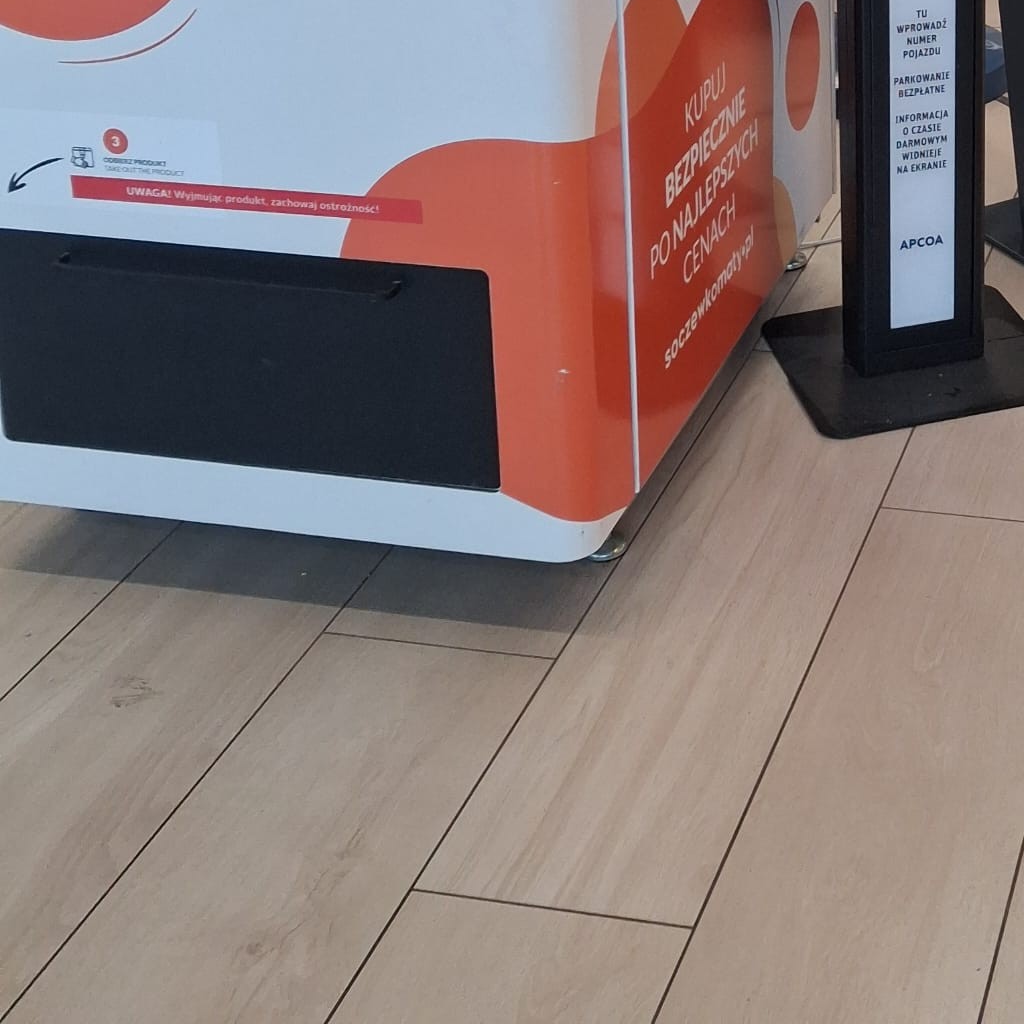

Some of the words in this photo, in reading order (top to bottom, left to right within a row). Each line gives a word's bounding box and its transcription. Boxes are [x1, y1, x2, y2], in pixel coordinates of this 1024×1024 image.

[916, 9, 927, 18] TU
[896, 19, 947, 33] WPROWADŹ
[906, 34, 937, 45] NUMER
[903, 47, 941, 59] POJAZDU
[893, 71, 950, 86] PARKOWANIE
[684, 62, 726, 133] KUPUJ
[898, 84, 945, 98] BEZPŁATNE
[895, 109, 949, 124] INFORMACJA
[902, 127, 909, 135] O
[911, 124, 942, 134] CZASIE
[111, 136, 120, 147] 3
[665, 86, 746, 208] BEZPIECZNIE
[896, 135, 948, 149] DARMOWYM
[902, 148, 942, 161] WIDNIEJE
[896, 166, 908, 175] NA
[911, 160, 947, 173] EKRANIE
[126, 187, 172, 199] UWAGA!
[270, 198, 318, 211] zachowaj
[650, 230, 670, 280] PO
[673, 118, 759, 251] NAJLEPSZYCH
[683, 193, 736, 284] CENACH
[900, 235, 943, 250] APCOA
